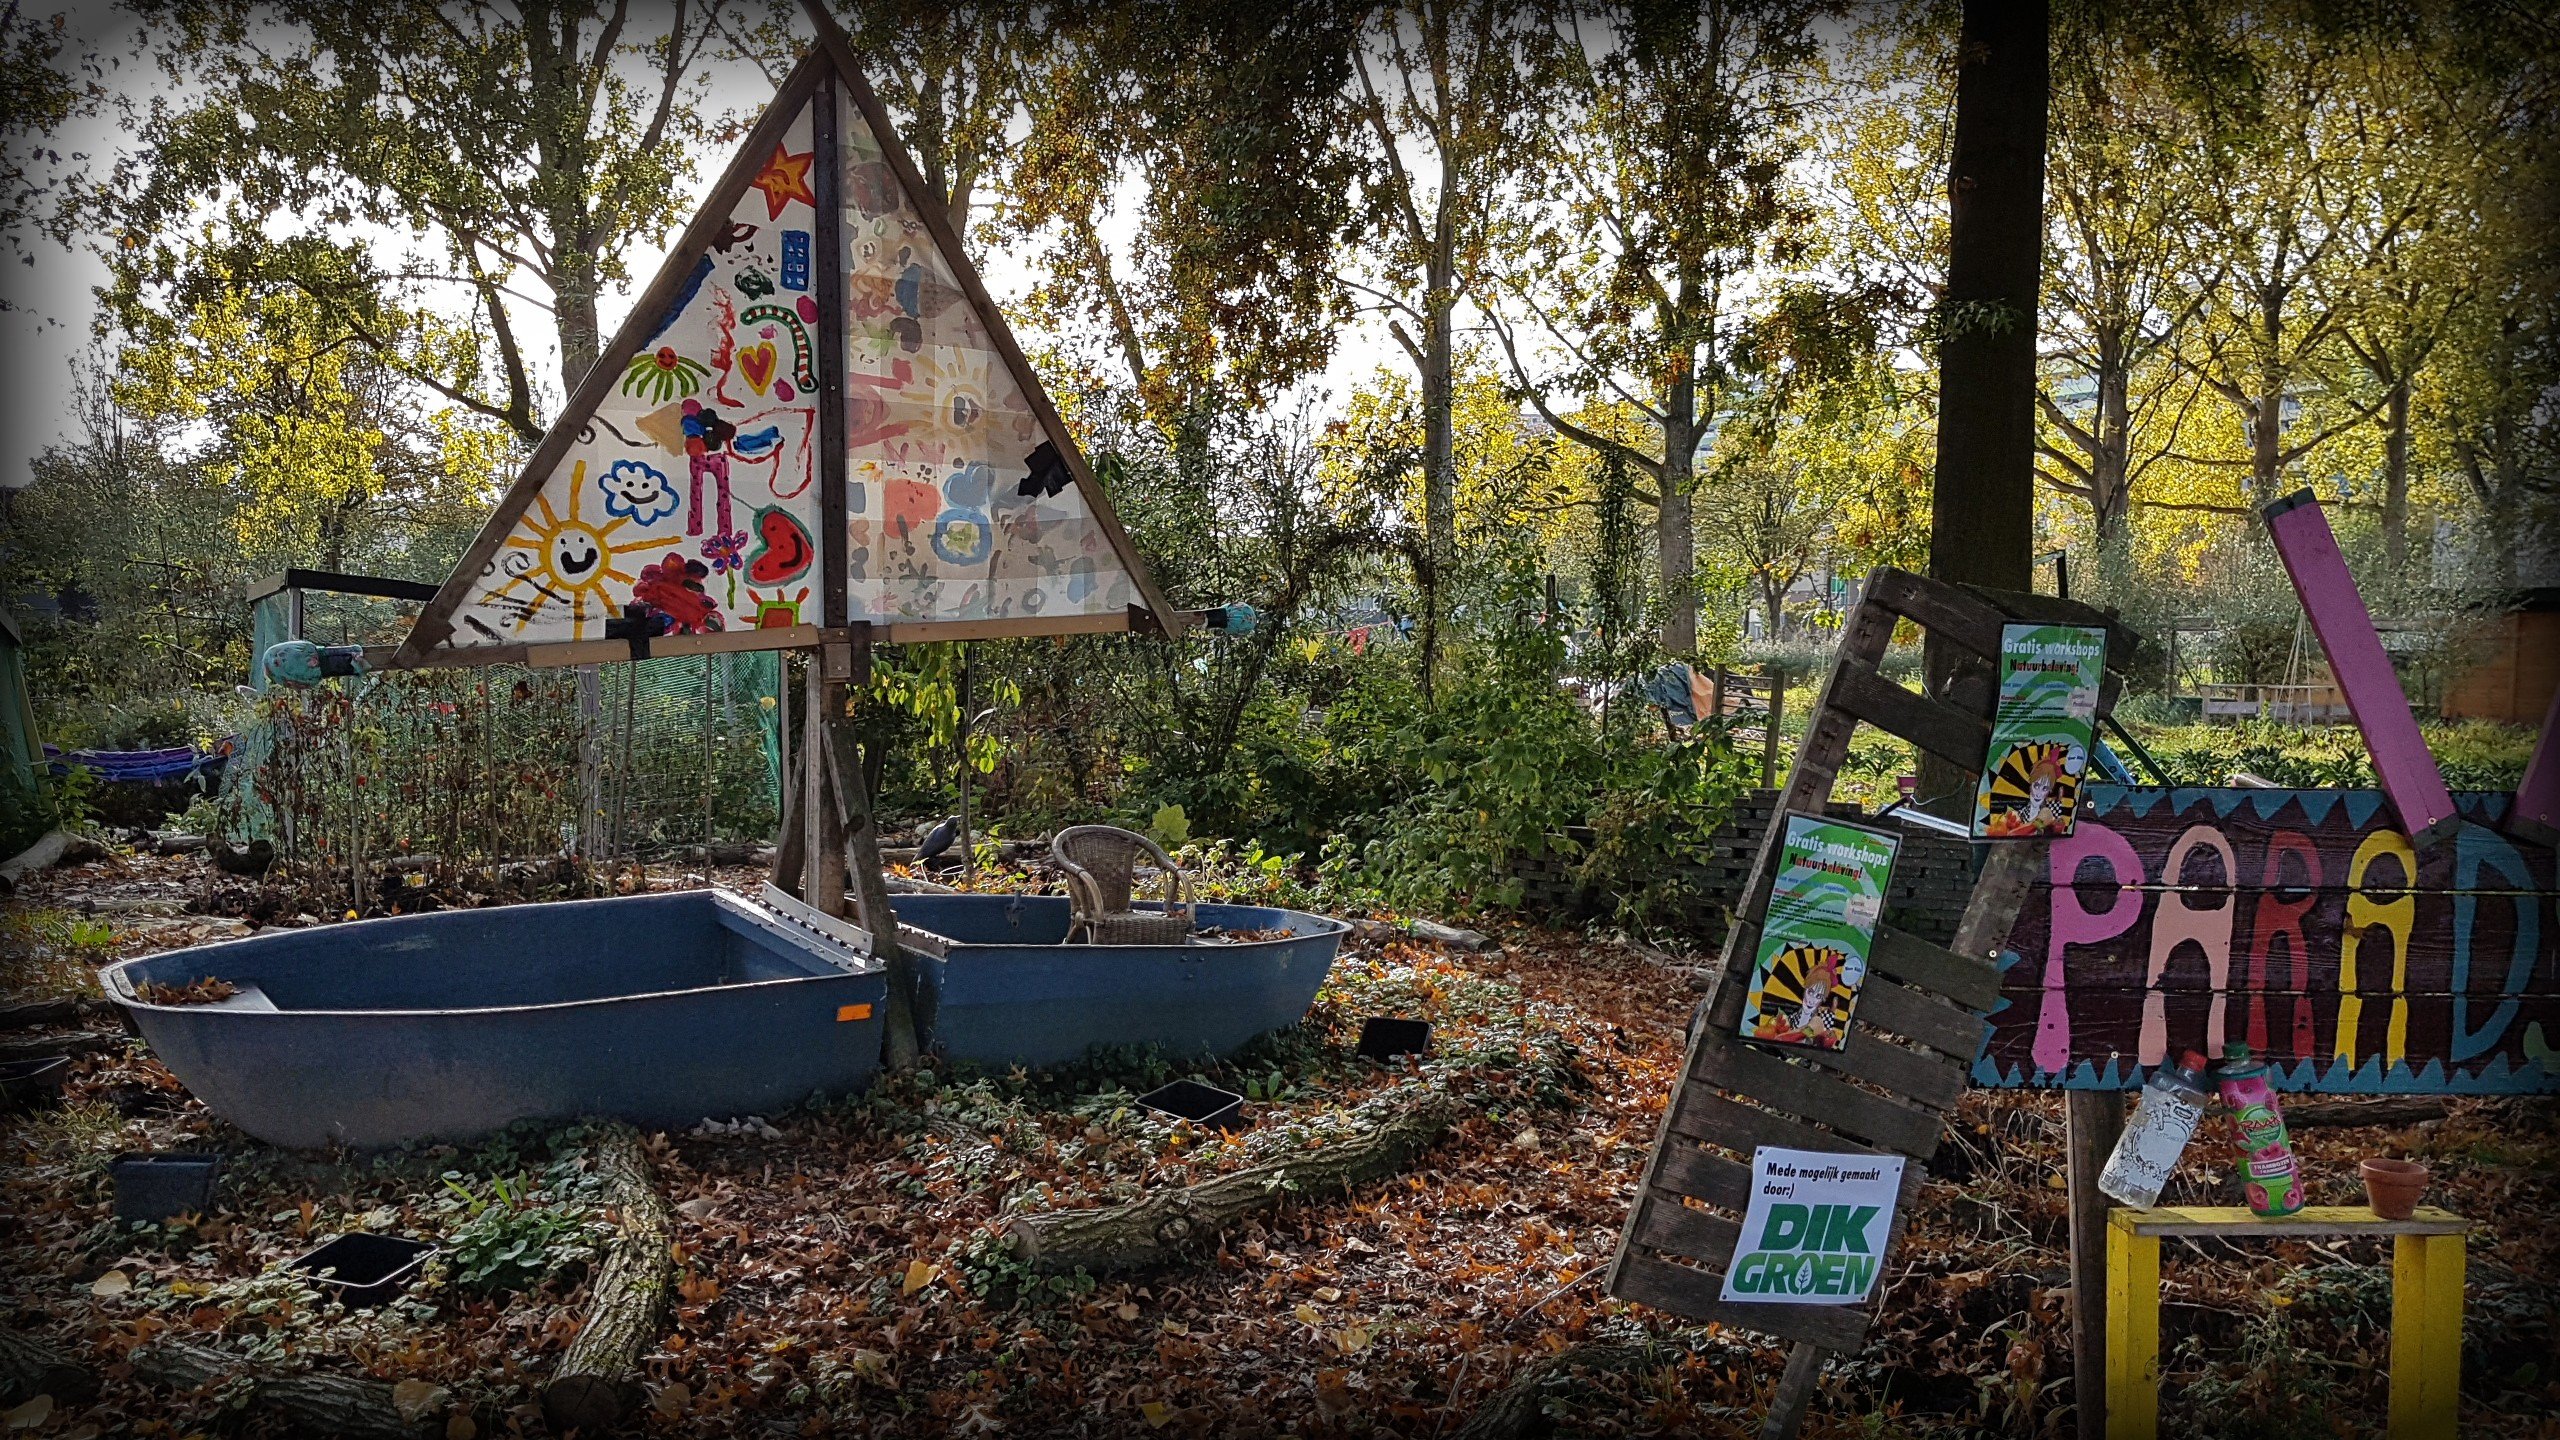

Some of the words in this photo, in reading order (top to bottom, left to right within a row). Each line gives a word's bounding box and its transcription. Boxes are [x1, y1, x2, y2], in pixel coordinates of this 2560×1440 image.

[2004, 638, 2042, 655] Gratis
[2044, 639, 2100, 660] workshops
[2010, 659, 2079, 676] Natuurbeleving!
[1787, 831, 1825, 853] Gratis
[1827, 842, 1888, 869] workshops
[1788, 852, 1863, 882] Natuurbeleving!
[2032, 820, 2560, 1075] PARAD
[1766, 1162, 1796, 1178] Mede
[1799, 1166, 1840, 1184] mogelijk
[1840, 1168, 1881, 1183] gemaakt
[1763, 1181, 1795, 1199] door:)
[1758, 1203, 1881, 1253] DIK
[1732, 1252, 1876, 1296] GROEN
